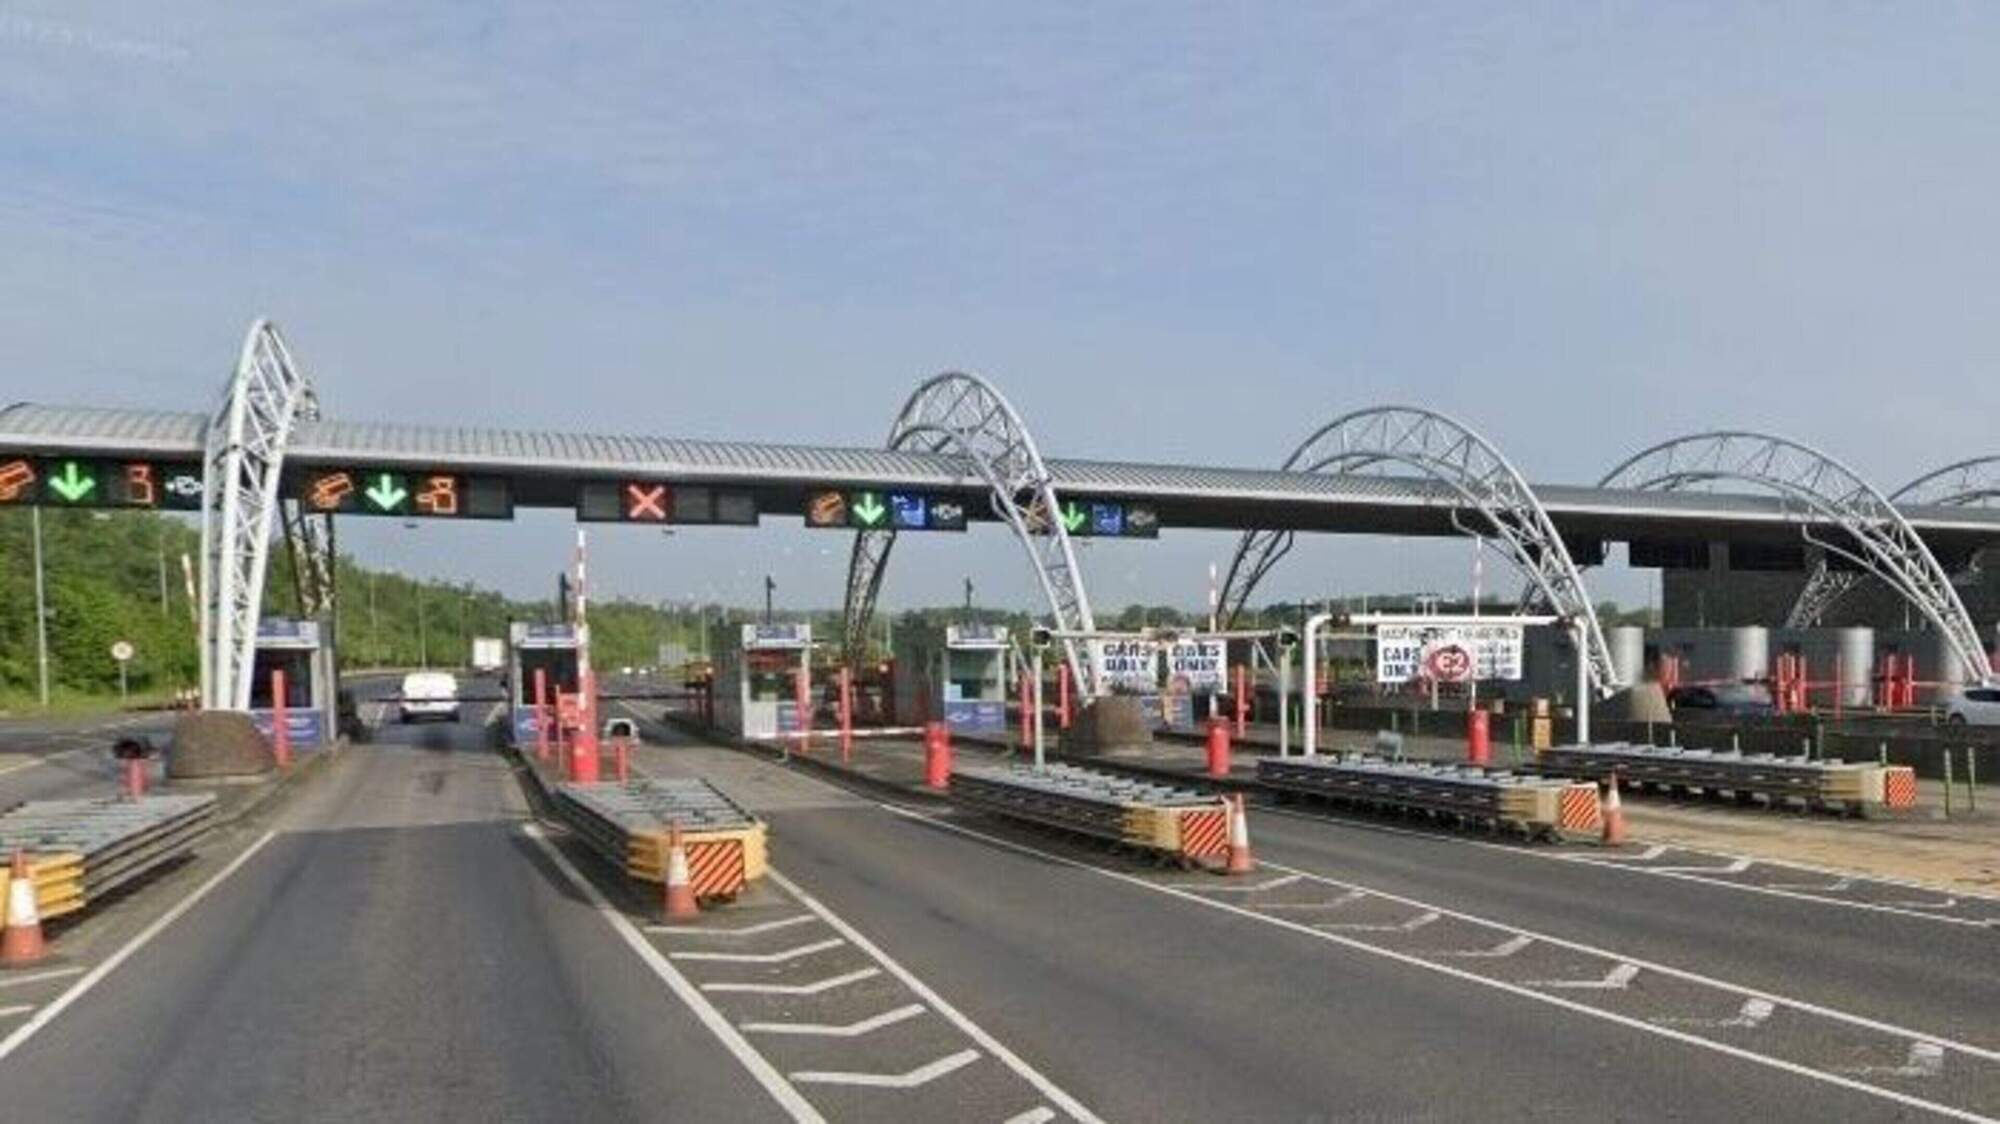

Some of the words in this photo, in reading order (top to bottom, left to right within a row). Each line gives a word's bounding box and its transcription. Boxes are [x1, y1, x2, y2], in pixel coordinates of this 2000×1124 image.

[1103, 641, 1152, 657] CARS
[1172, 643, 1220, 657] CARS
[1382, 647, 1421, 662] CARS
